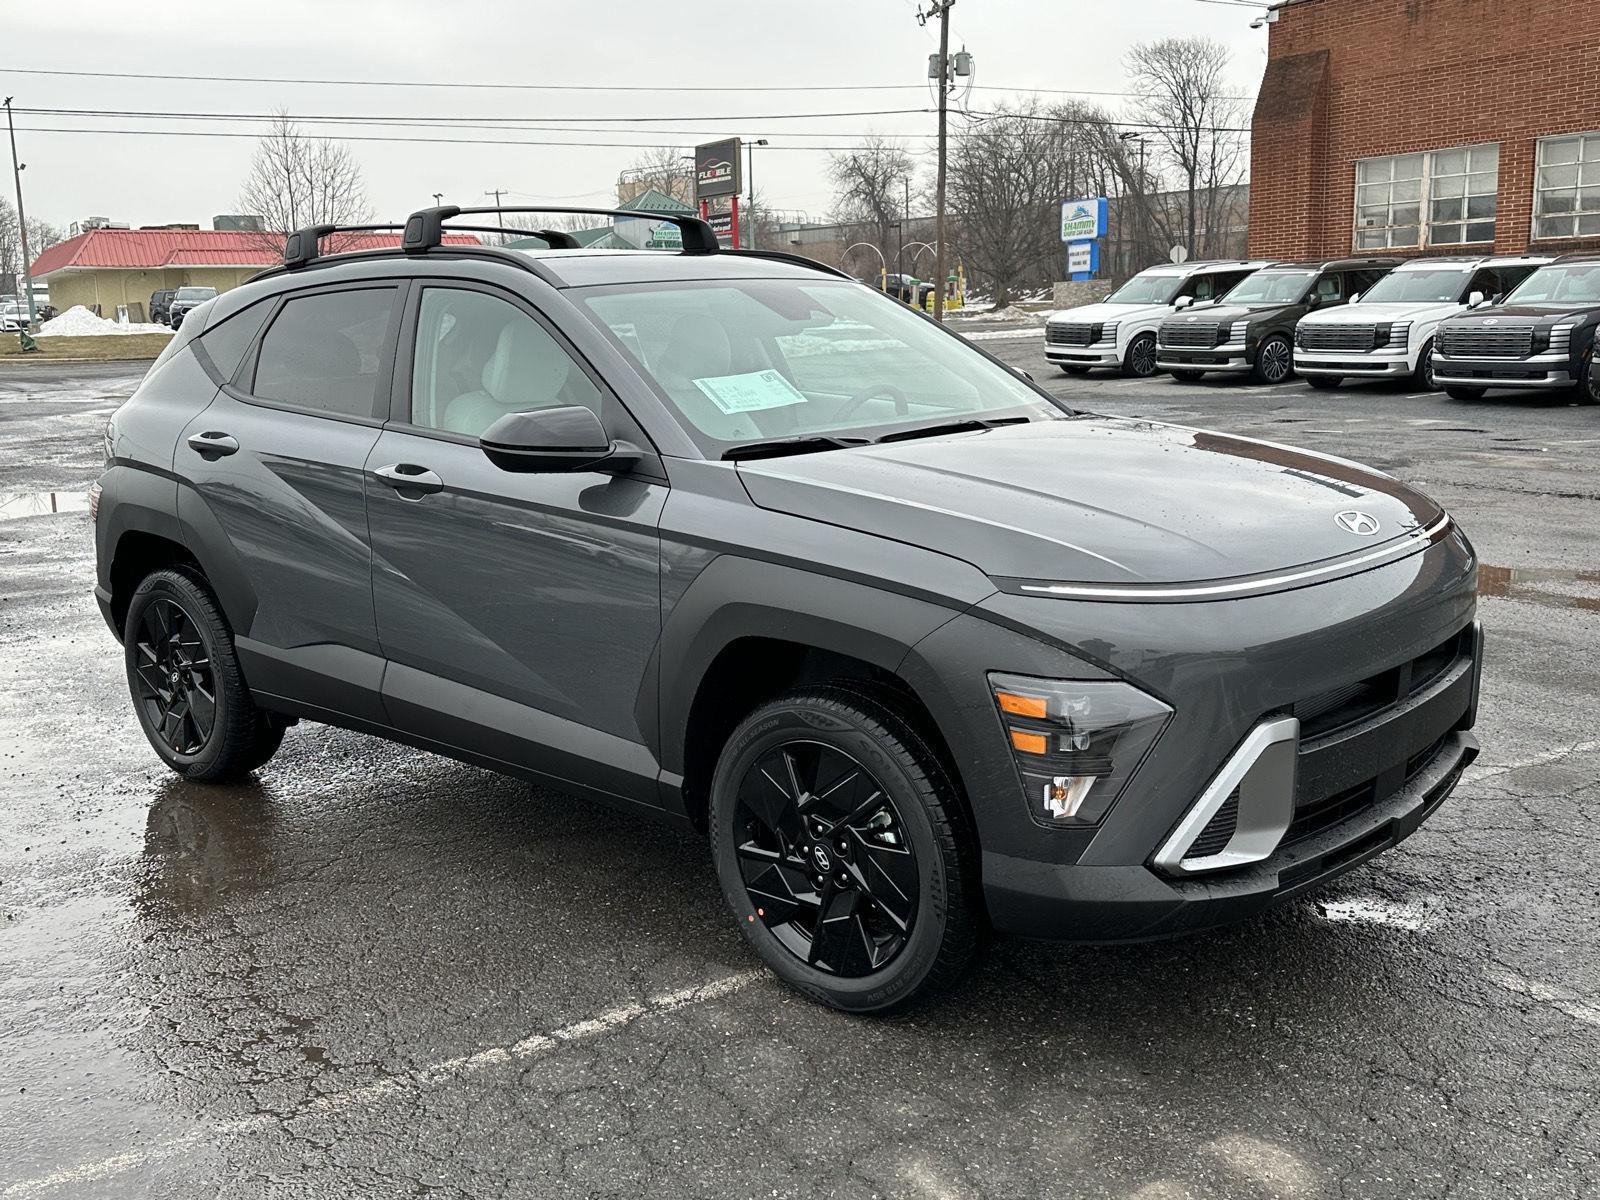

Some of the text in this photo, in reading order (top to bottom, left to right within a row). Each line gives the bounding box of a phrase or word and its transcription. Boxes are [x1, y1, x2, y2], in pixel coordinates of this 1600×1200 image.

[1064, 219, 1095, 230] SHAMMY
[645, 240, 683, 248] CAR WAS
